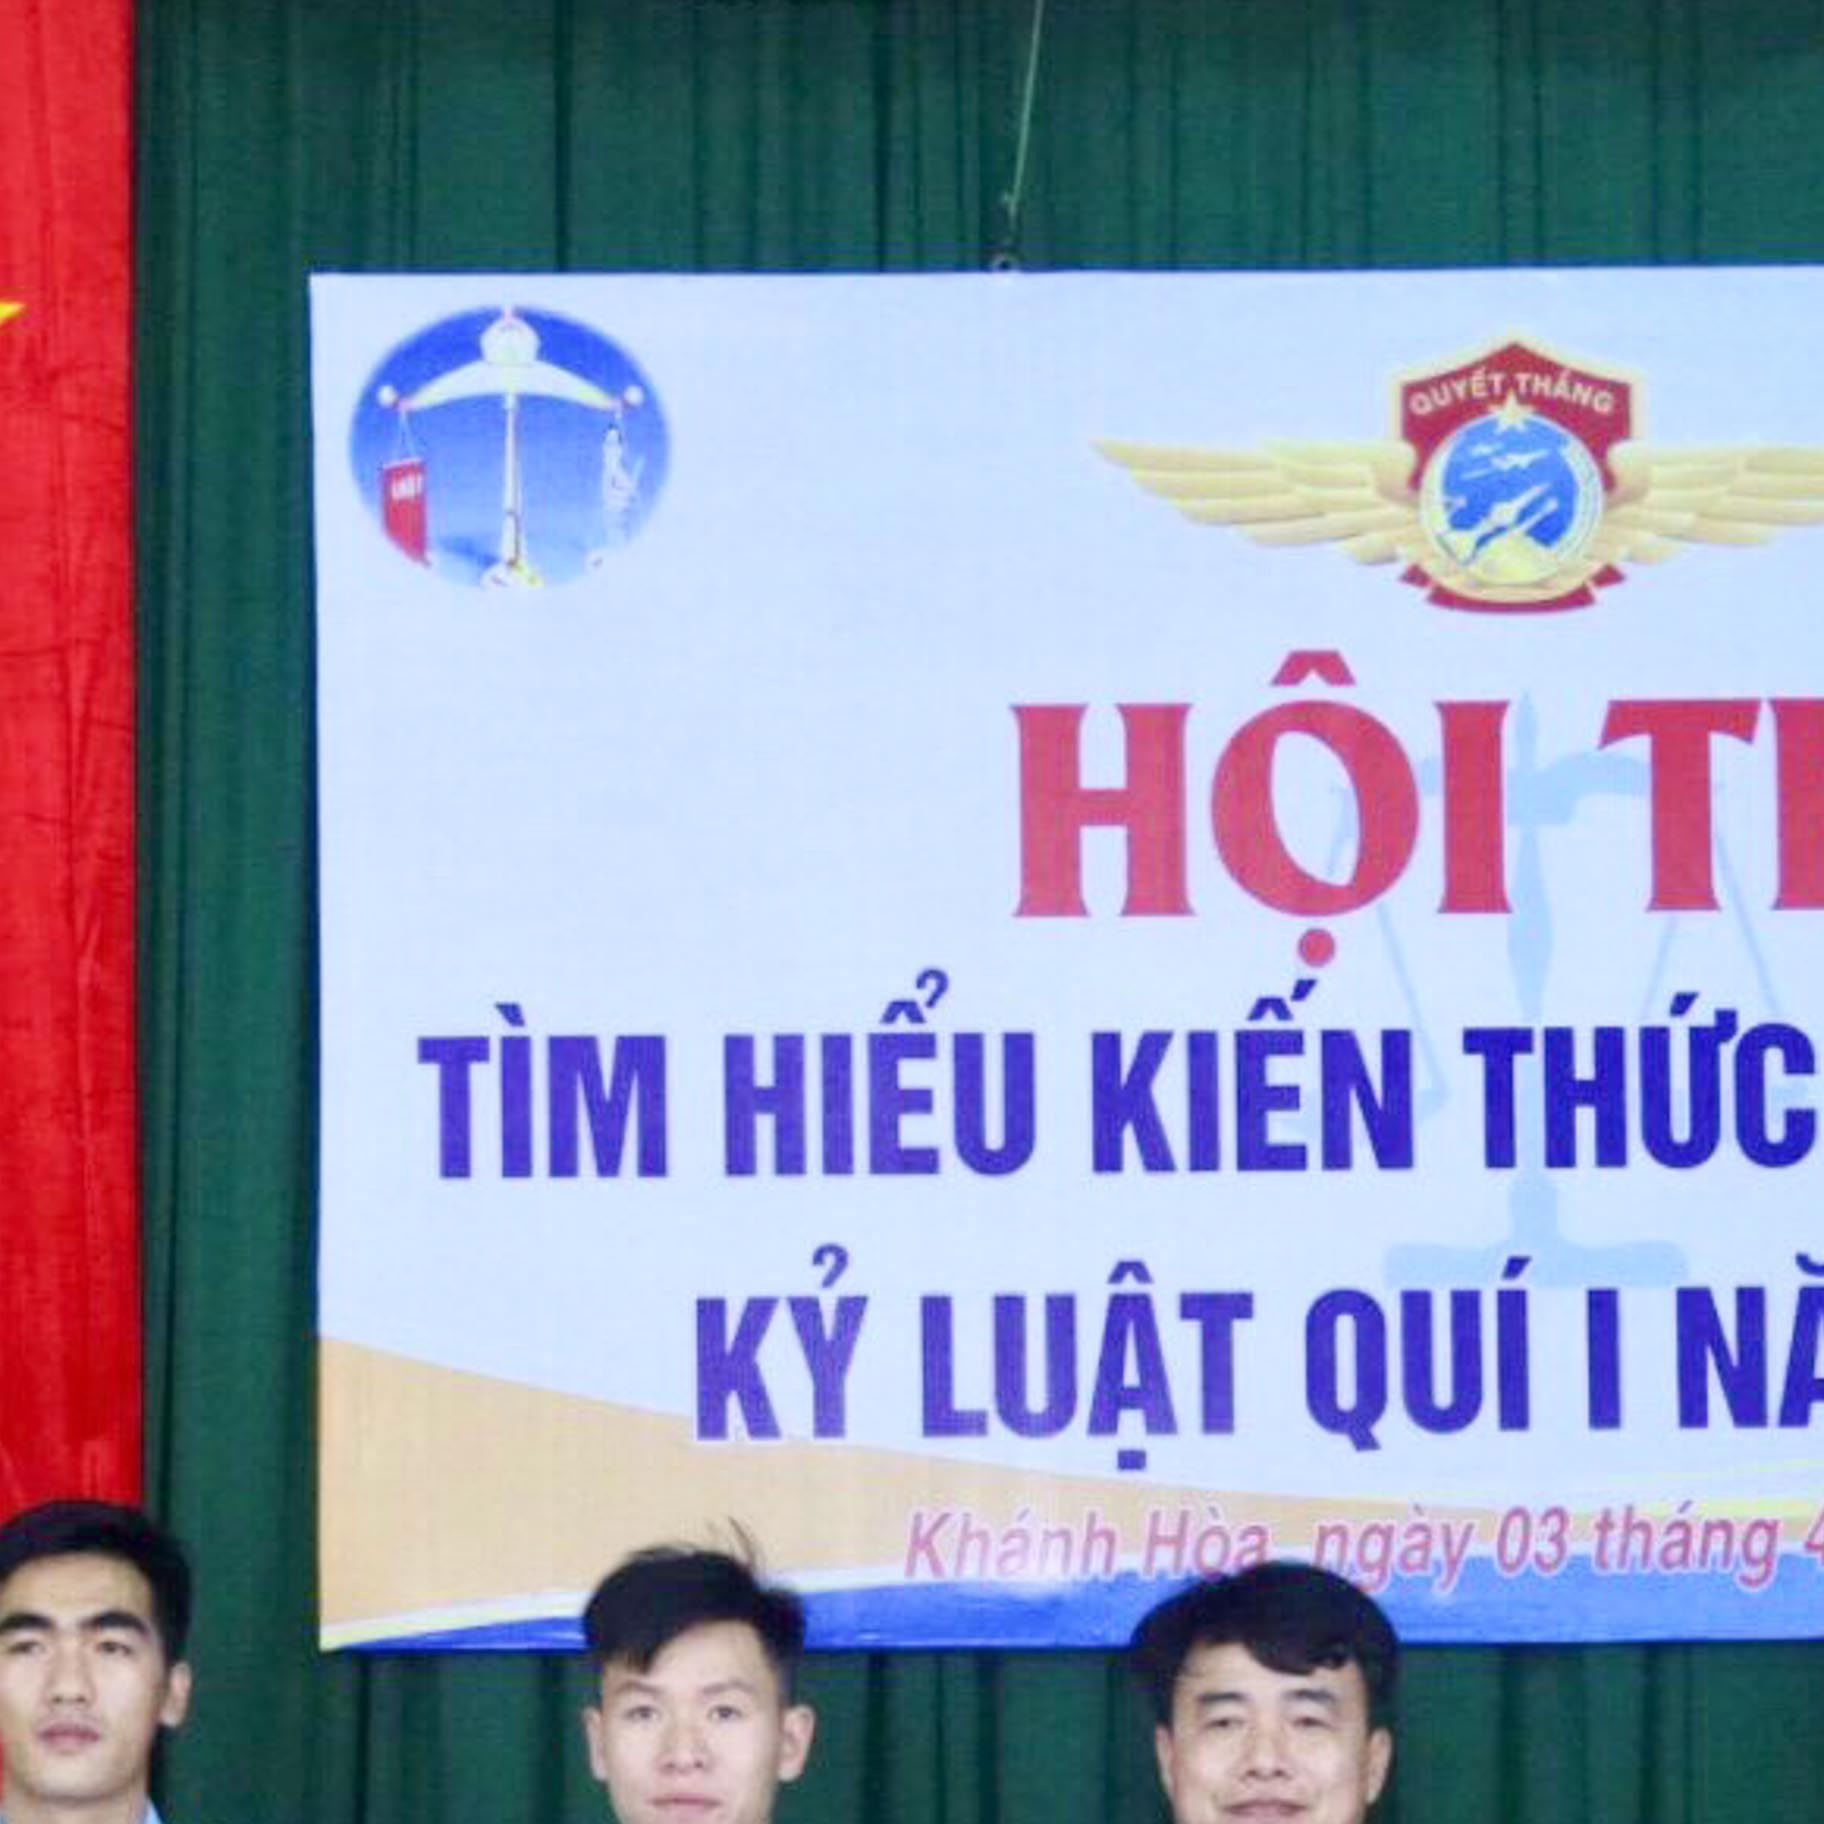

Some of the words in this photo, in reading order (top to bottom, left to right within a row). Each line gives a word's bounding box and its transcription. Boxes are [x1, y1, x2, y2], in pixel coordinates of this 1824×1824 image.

[1408, 367, 1505, 415] QUYẾT
[1011, 650, 1513, 967] HỘI
[417, 1001, 669, 1180] TÌM
[722, 967, 1037, 1178] HIỂU
[1090, 977, 1415, 1175] KIẾN
[1460, 990, 1818, 1171] THỨC
[694, 1243, 870, 1440] KỶ
[920, 1259, 1255, 1472] LUẬT
[1303, 1254, 1532, 1453] QUÍ
[1584, 1286, 1622, 1431] I
[904, 1507, 1118, 1579] Khánh
[1313, 1503, 1474, 1594] ngày
[1496, 1506, 1570, 1573] 03
[1593, 1499, 1779, 1588] tháng
